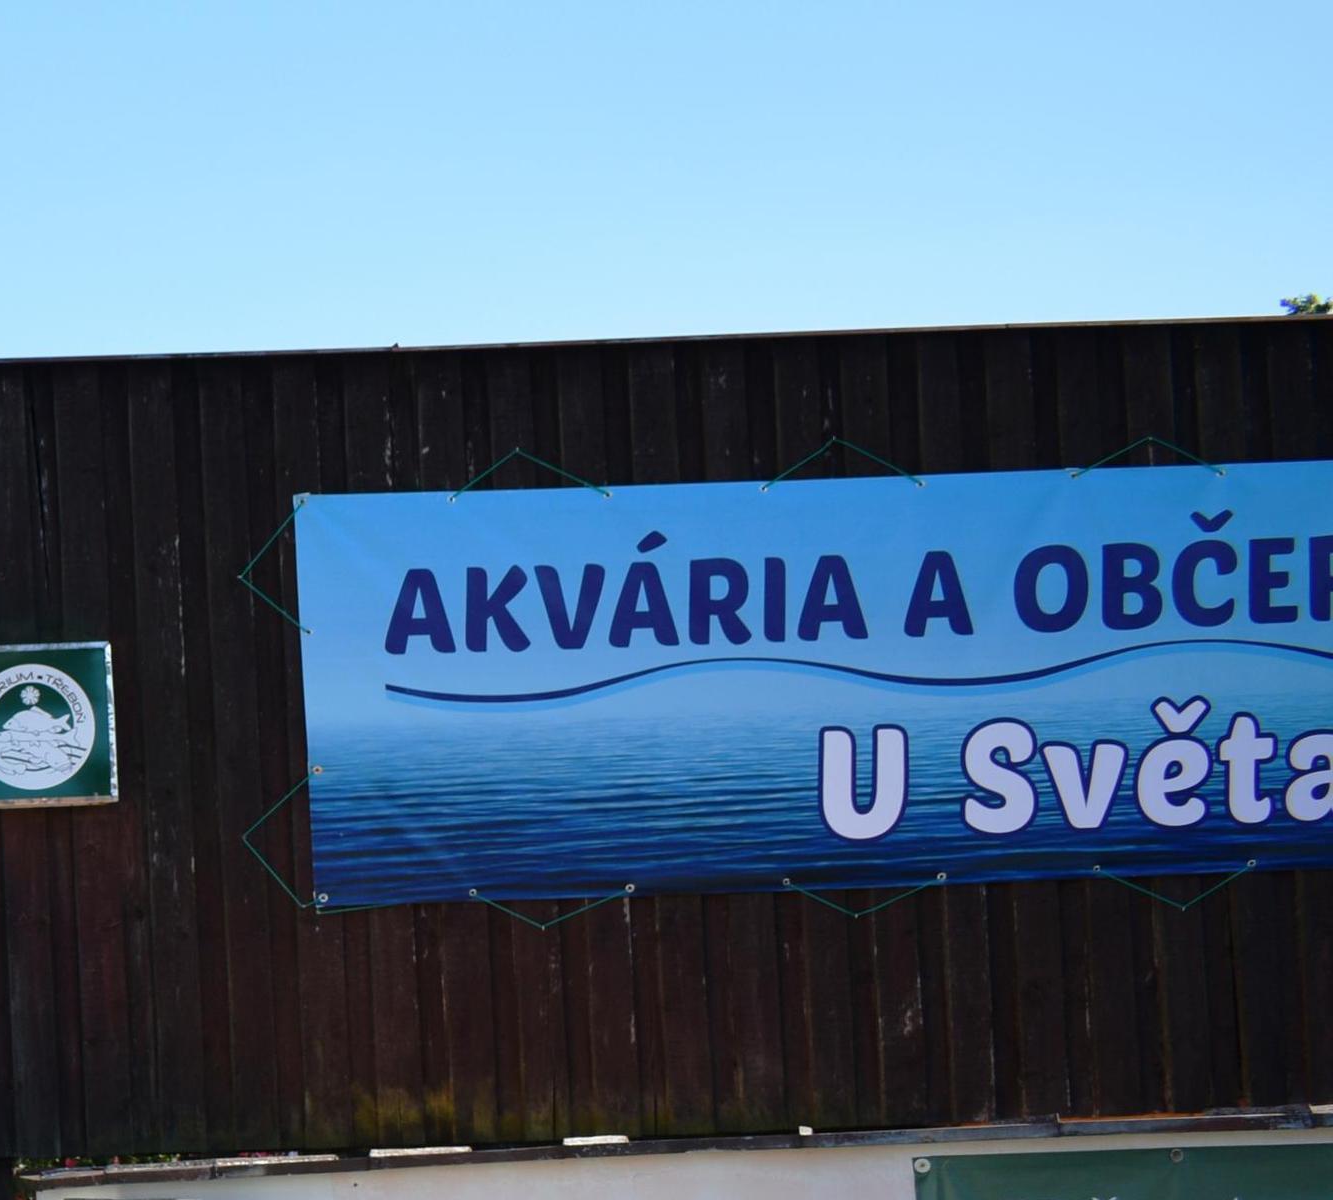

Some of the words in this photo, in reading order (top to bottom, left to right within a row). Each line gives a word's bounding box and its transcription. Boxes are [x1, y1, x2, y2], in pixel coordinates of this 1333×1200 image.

[385, 531, 869, 655] AKVÁRIA
[903, 550, 974, 637] A
[818, 723, 910, 842] U
